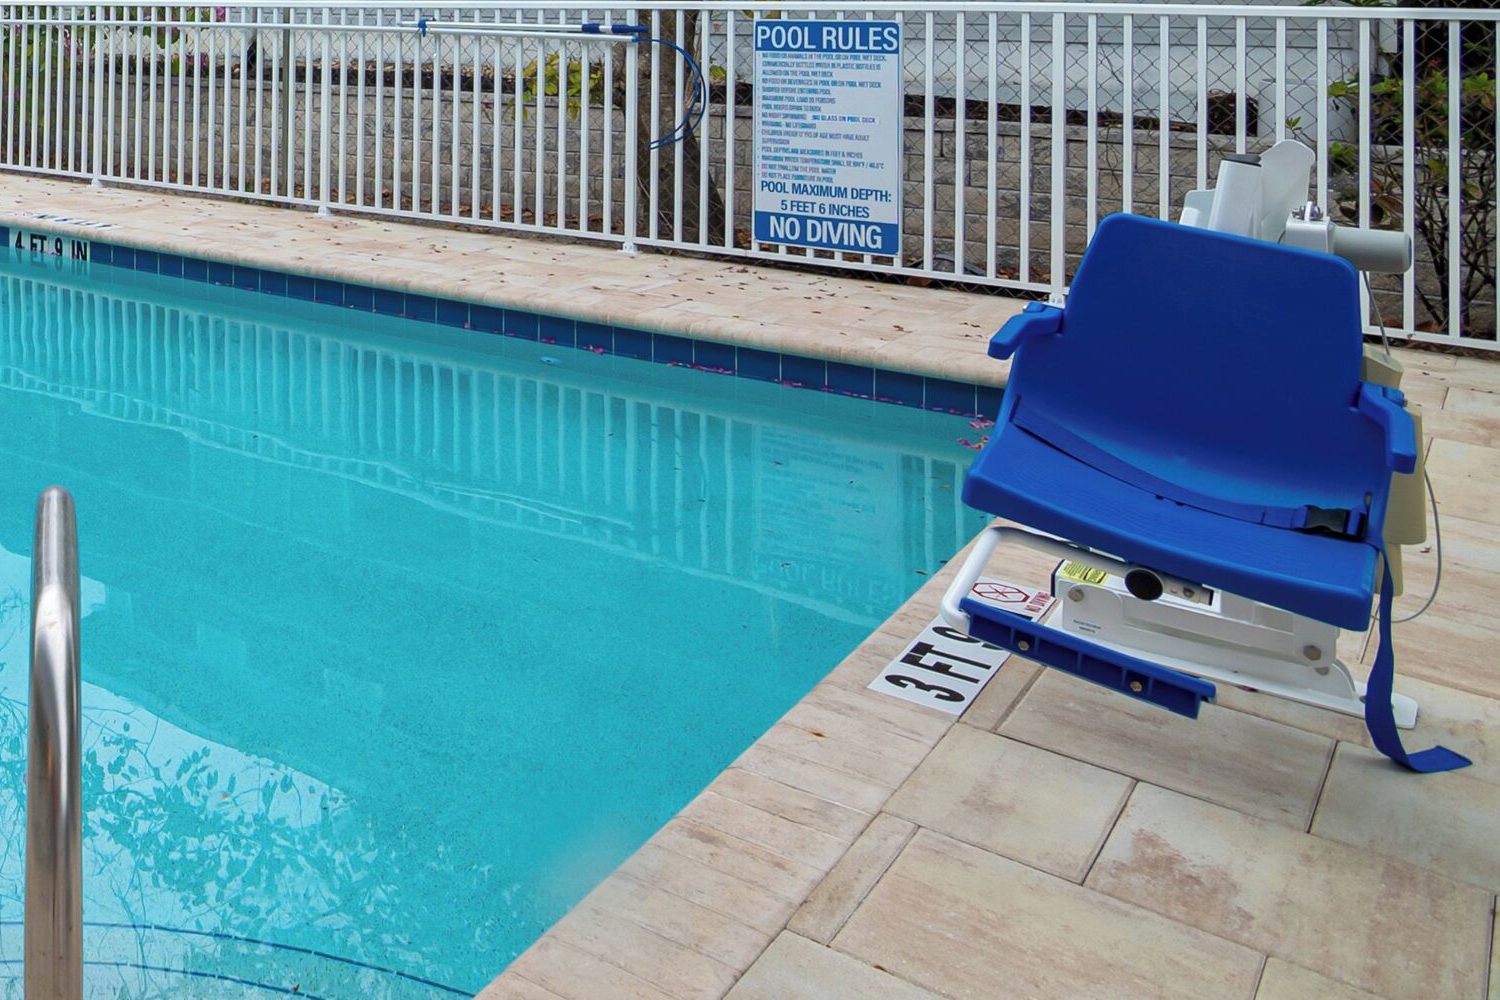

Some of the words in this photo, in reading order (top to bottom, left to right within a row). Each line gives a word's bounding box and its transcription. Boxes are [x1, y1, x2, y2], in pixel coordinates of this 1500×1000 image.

[757, 26, 816, 49] POOL
[823, 27, 898, 51] RULES
[761, 180, 789, 193] POOL
[792, 183, 848, 199] MAXIMUM
[851, 188, 892, 203] DEPTH:
[781, 199, 788, 211] 5
[790, 200, 816, 213] FEET
[819, 203, 826, 215] 6
[829, 204, 869, 218] INCHES
[15, 231, 25, 249] 4
[30, 233, 47, 253] FT
[54, 237, 63, 257] 9
[71, 240, 88, 262] IN
[769, 216, 800, 241] NO
[806, 219, 882, 249] DIVING
[900, 641, 992, 685] FT
[884, 674, 966, 703] 3
